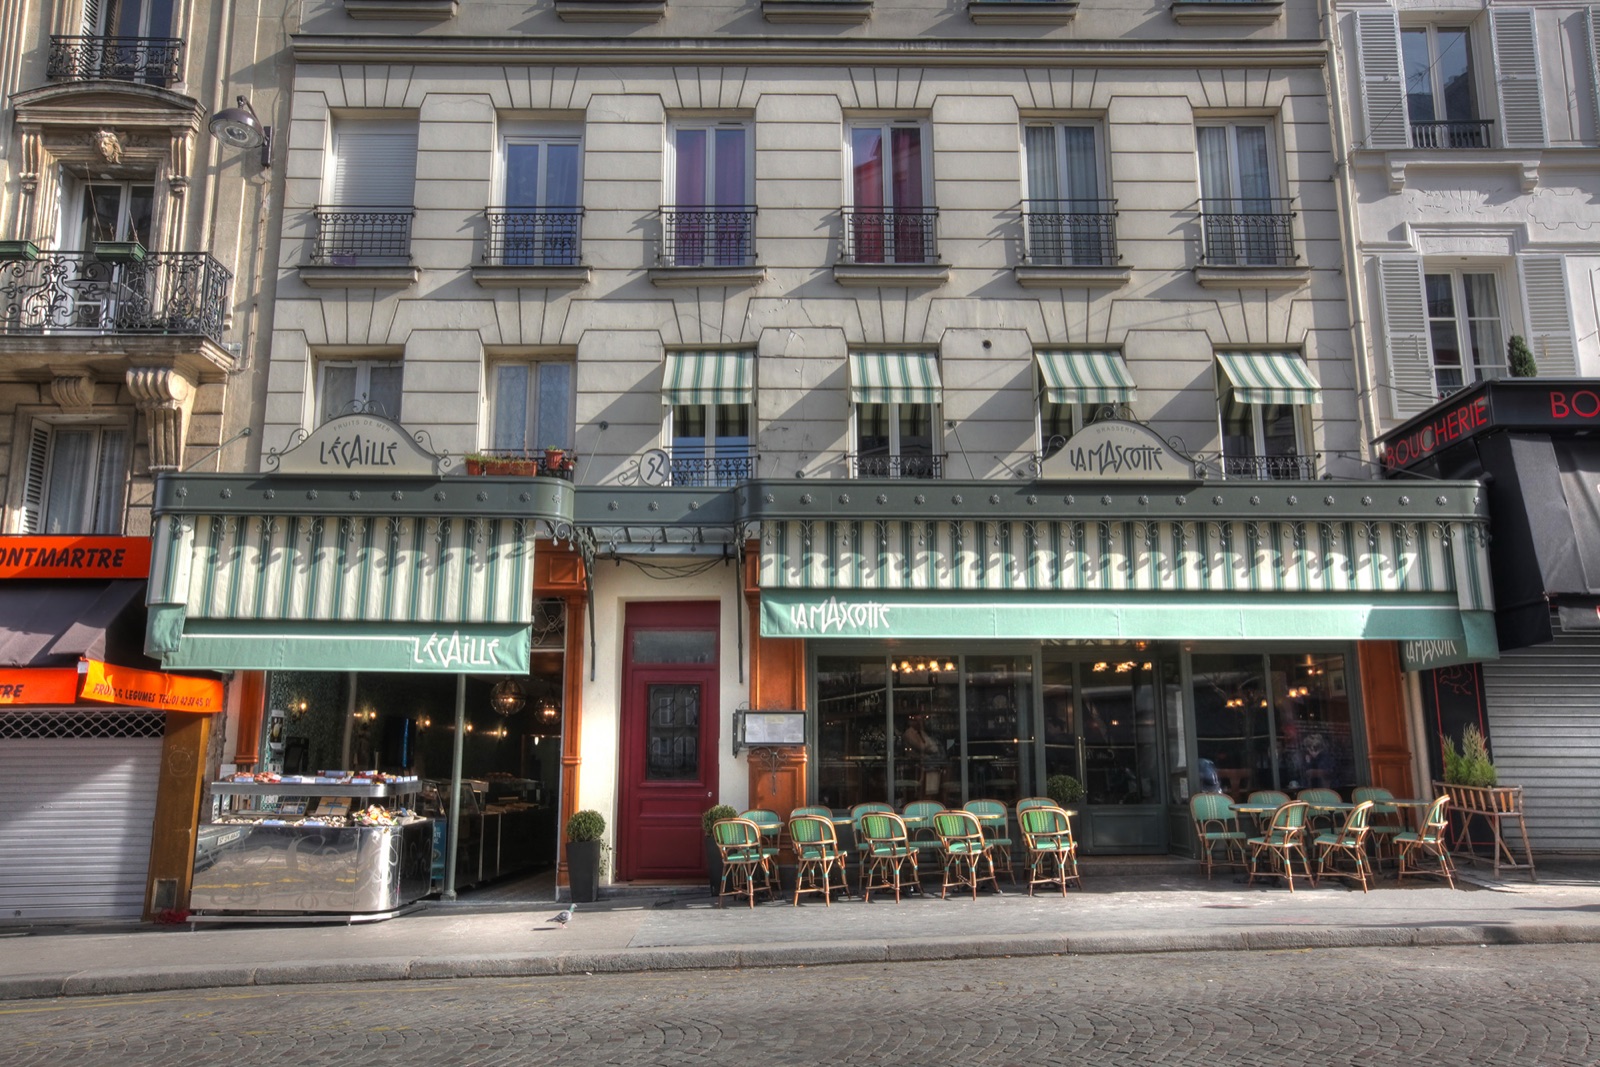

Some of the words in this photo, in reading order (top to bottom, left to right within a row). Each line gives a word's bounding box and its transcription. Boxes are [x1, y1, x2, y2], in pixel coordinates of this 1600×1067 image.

[333, 420, 360, 432] FRUITS
[363, 419, 373, 427] DE
[376, 422, 391, 433] MER
[1095, 425, 1137, 435] BRASSERIE
[1386, 396, 1487, 470] BOUCHERIE
[647, 453, 664, 480] 52
[125, 689, 156, 703] LEGUMES
